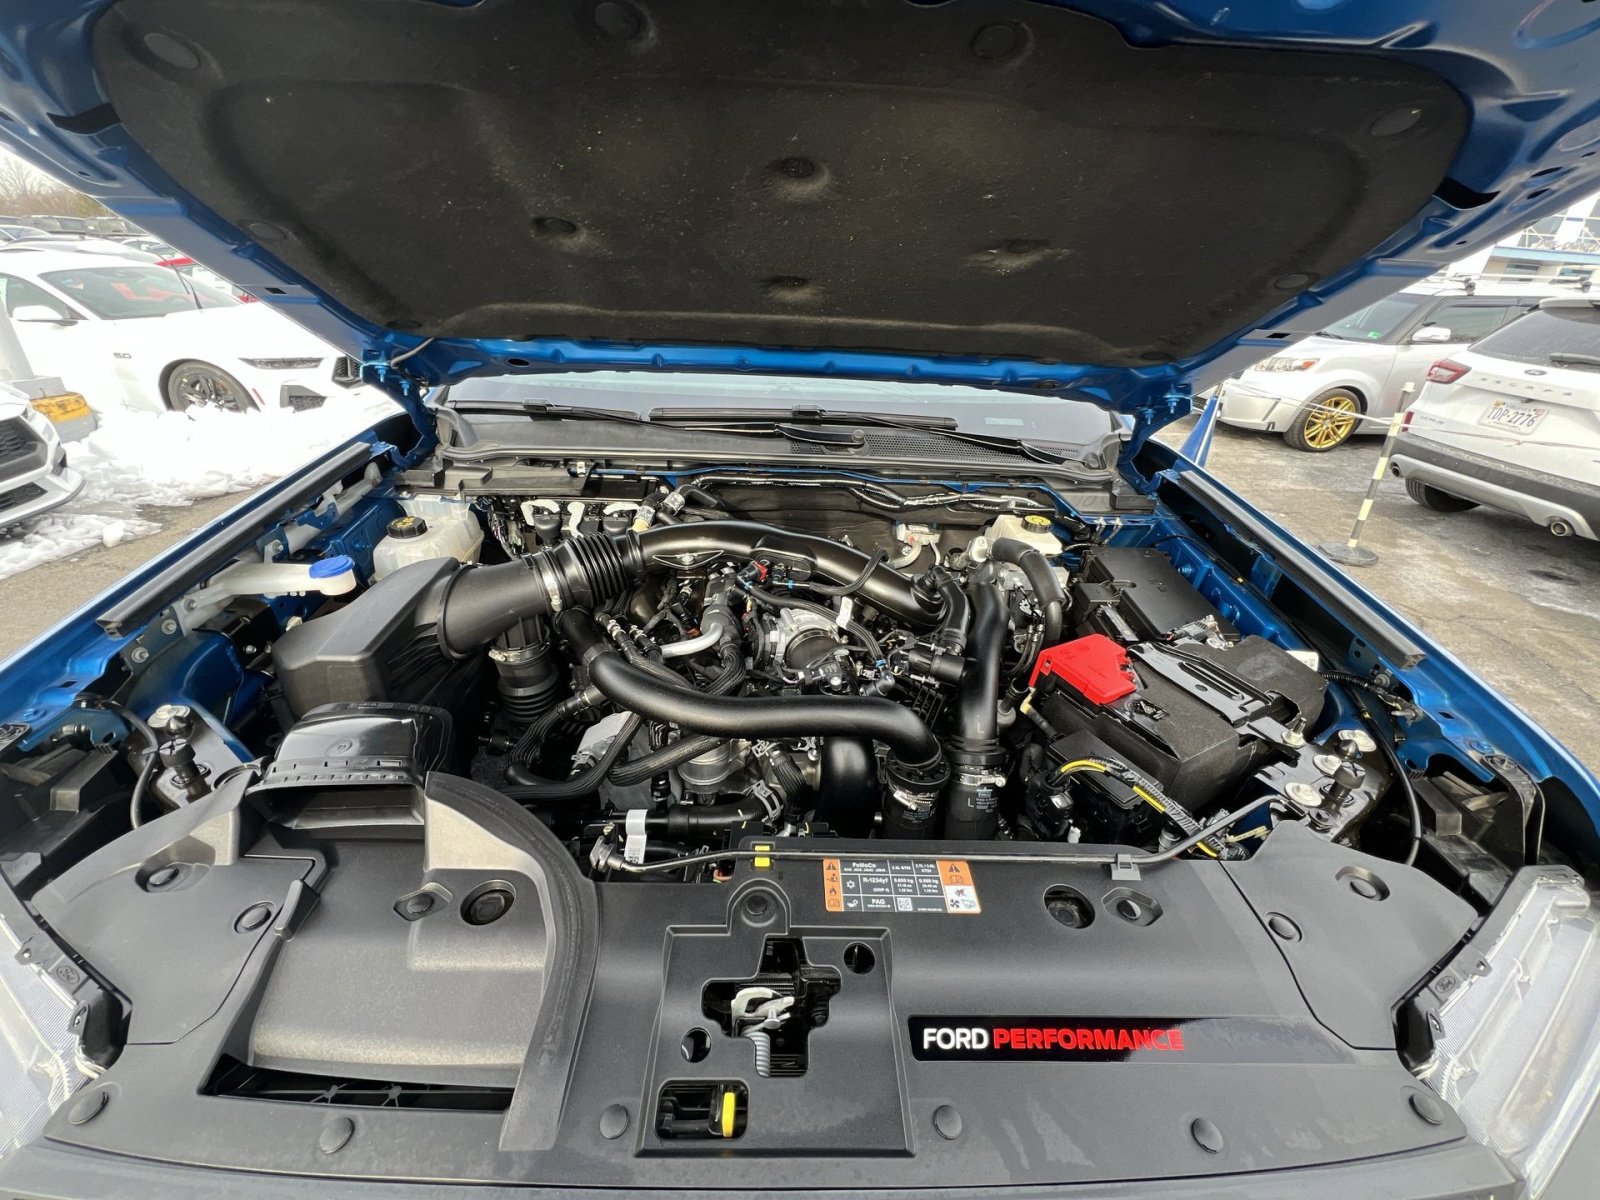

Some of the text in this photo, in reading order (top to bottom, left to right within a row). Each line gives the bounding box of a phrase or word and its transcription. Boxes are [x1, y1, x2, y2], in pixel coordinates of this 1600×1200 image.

[863, 877, 888, 885] R-1234yf
[923, 1028, 1185, 1051] FORD PERFORMANCE
